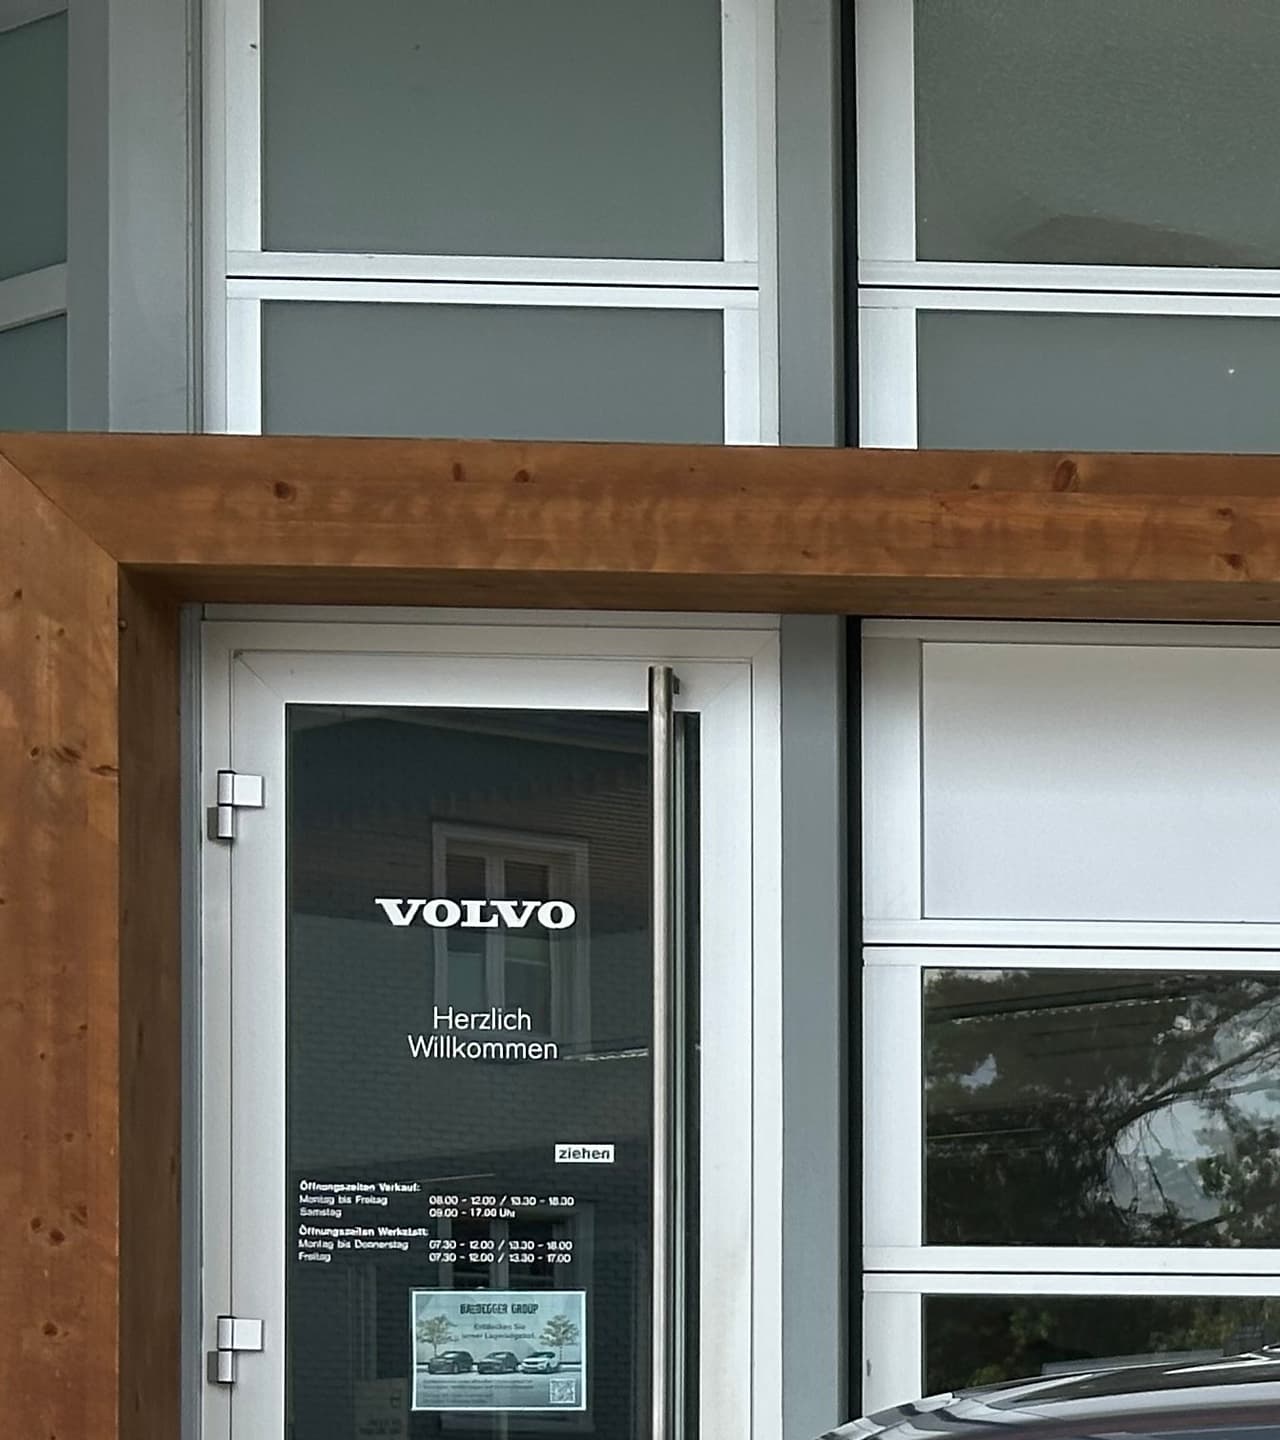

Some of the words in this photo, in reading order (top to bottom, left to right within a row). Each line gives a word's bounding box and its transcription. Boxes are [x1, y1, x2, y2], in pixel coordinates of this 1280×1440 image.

[375, 897, 576, 930] VOLVO
[433, 1006, 532, 1031] Herzlich
[407, 1035, 559, 1060] Willkommen
[558, 1147, 611, 1161] ziehen
[300, 1207, 342, 1218] Samstag
[470, 1208, 497, 1218] 17.00
